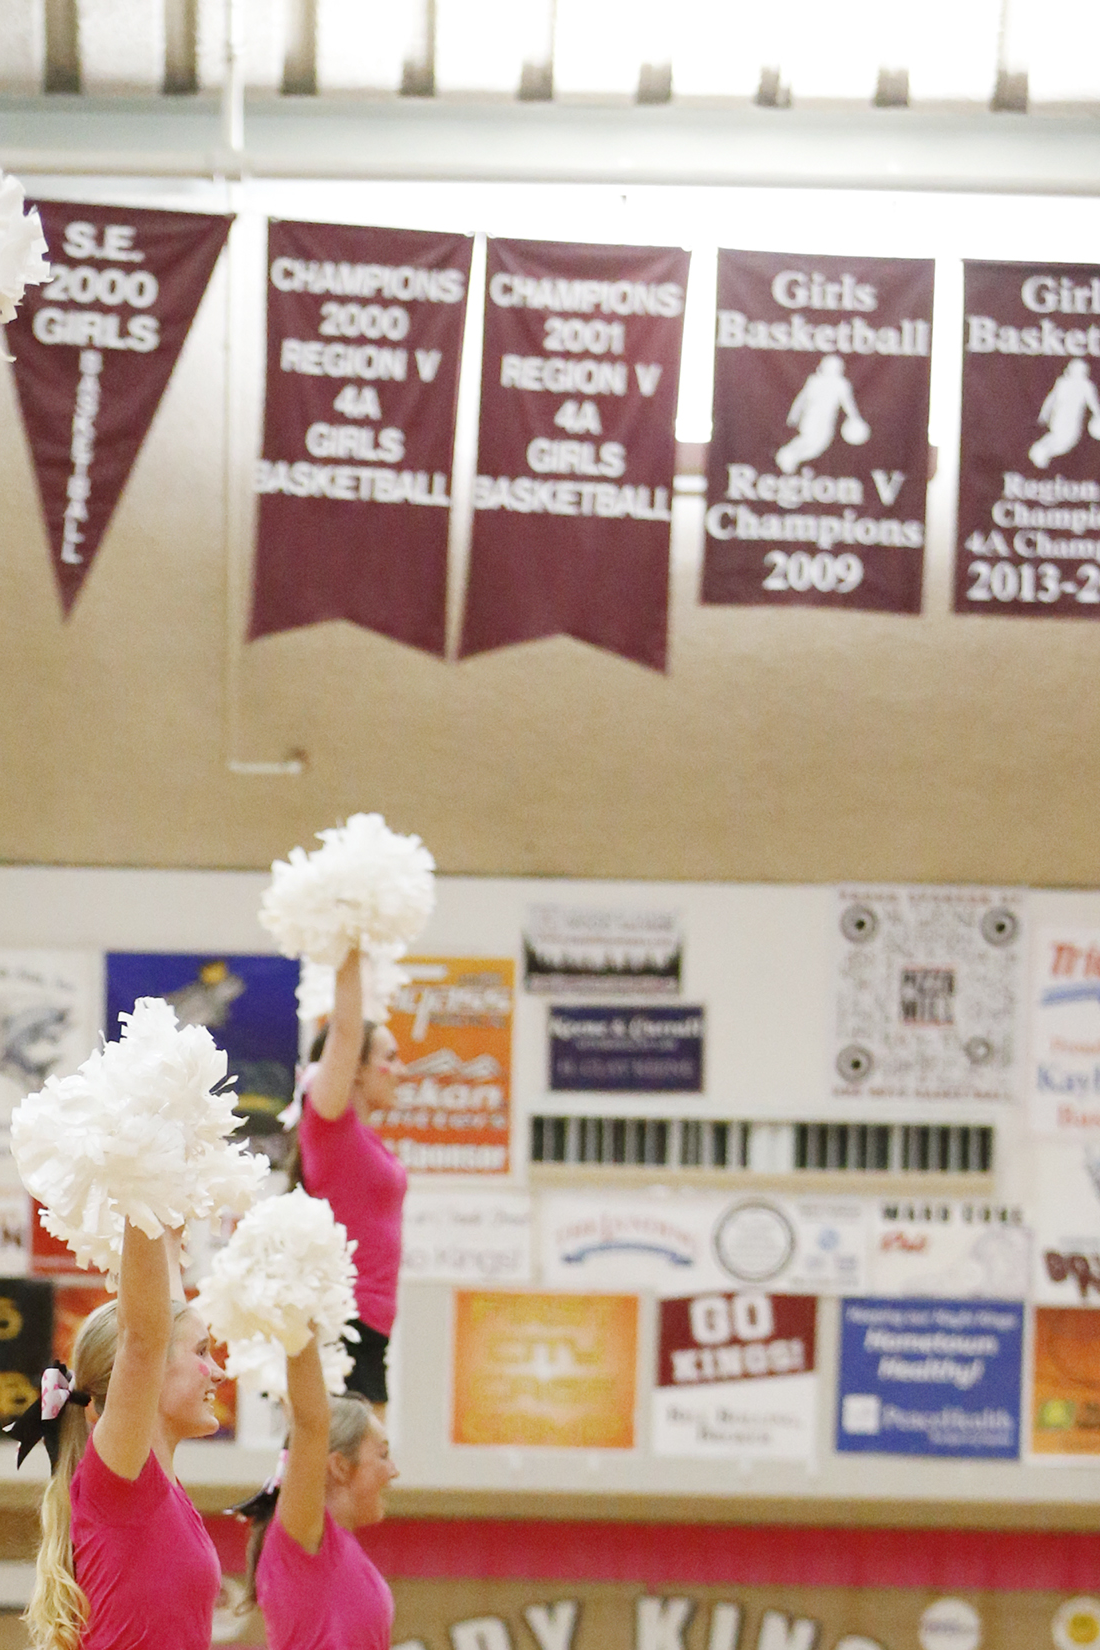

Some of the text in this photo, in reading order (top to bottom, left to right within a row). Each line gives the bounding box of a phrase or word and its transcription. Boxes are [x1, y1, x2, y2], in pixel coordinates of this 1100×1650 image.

[63, 221, 145, 263] S.E.
[42, 264, 159, 308] 2000
[271, 257, 466, 305] CHAMPIONS
[490, 272, 684, 318] CHAMPIONS
[771, 270, 878, 312] Girls
[1021, 275, 1100, 314] Girl
[32, 307, 161, 353] GIRLS
[319, 303, 410, 341] 2000
[544, 320, 625, 354] 2001
[717, 311, 930, 356] Basketball
[967, 314, 1100, 357] Basket
[281, 339, 442, 383] REGION V
[501, 355, 662, 397] REGION V
[333, 385, 381, 420] 4A
[554, 401, 603, 435] 4A
[60, 350, 103, 565] BASKETBALL
[305, 423, 405, 463] GIRLS
[526, 439, 626, 478] GIRLS
[252, 460, 453, 508] BASKETBALL
[473, 476, 671, 521] BASKETBALL
[726, 463, 904, 508] Region V
[706, 504, 923, 549] Champions
[991, 499, 1100, 535] Champi
[964, 528, 1011, 558] 4A
[762, 551, 864, 594] 2009
[966, 560, 1100, 603] 2013-2
[688, 1292, 774, 1346] GO
[671, 1338, 805, 1384] KINGS!
[864, 1325, 1000, 1357] Hometown
[877, 1354, 986, 1391] Healthy!
